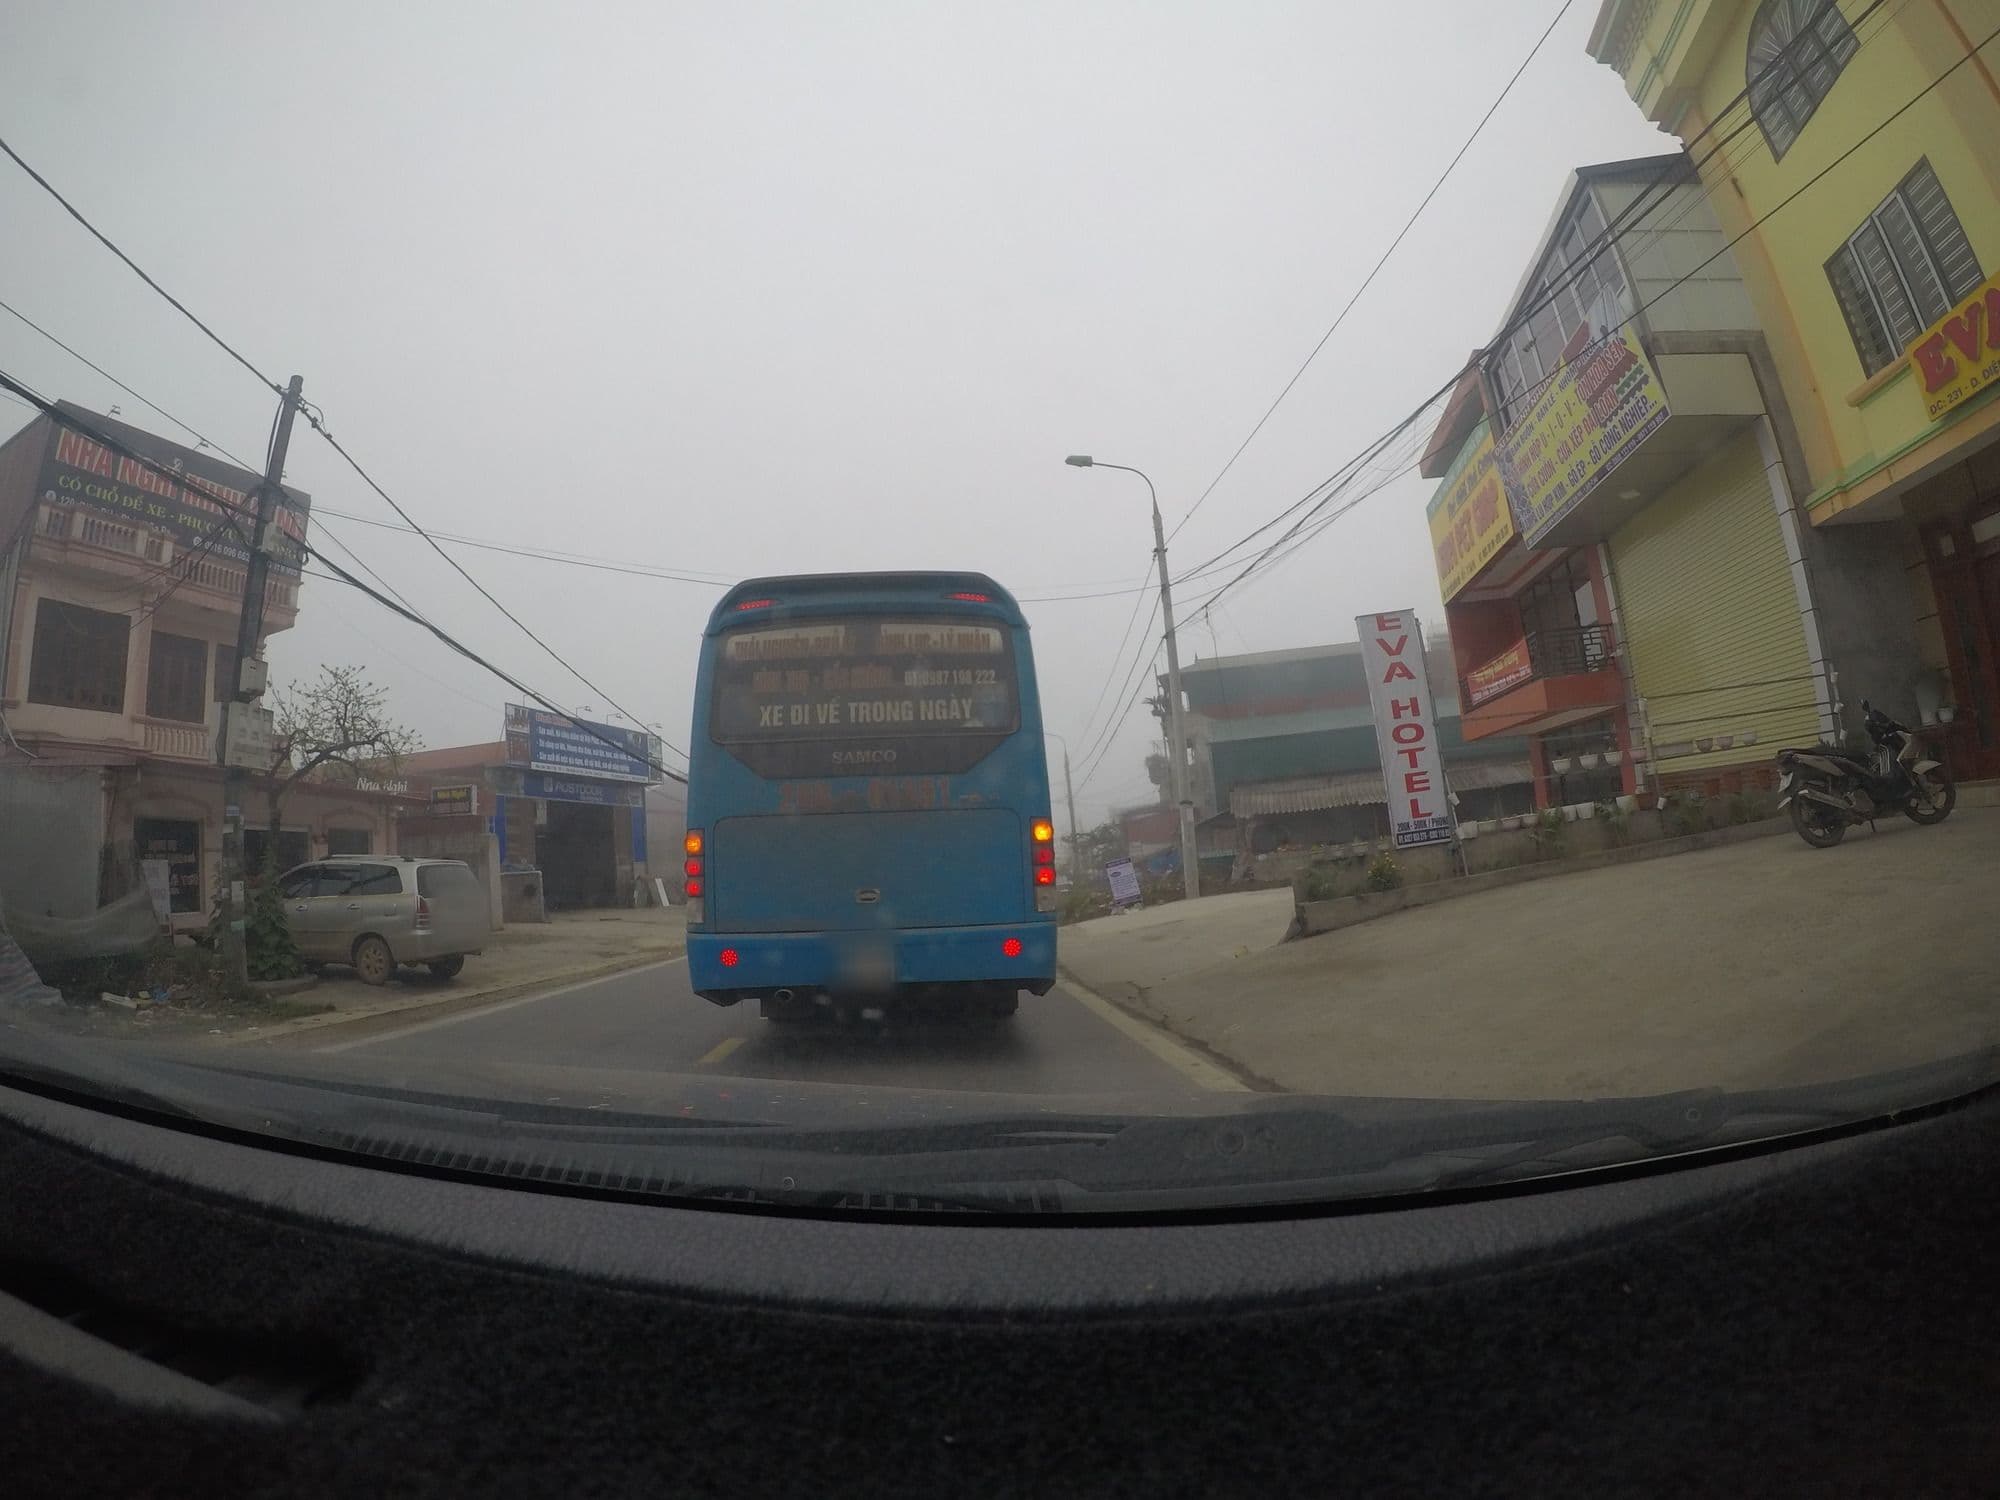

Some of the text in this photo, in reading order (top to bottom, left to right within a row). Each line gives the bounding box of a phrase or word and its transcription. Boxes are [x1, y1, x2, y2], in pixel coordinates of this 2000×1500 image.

[147, 503, 166, 518] XE
[1376, 615, 1416, 683] EVA
[975, 669, 997, 684] 222
[760, 704, 784, 727] XE
[790, 703, 809, 725] ĐI
[848, 701, 914, 723] TRONG
[919, 694, 974, 721] NGÀY
[831, 749, 897, 765] SAMCO
[1391, 696, 1432, 819] HOTEL
